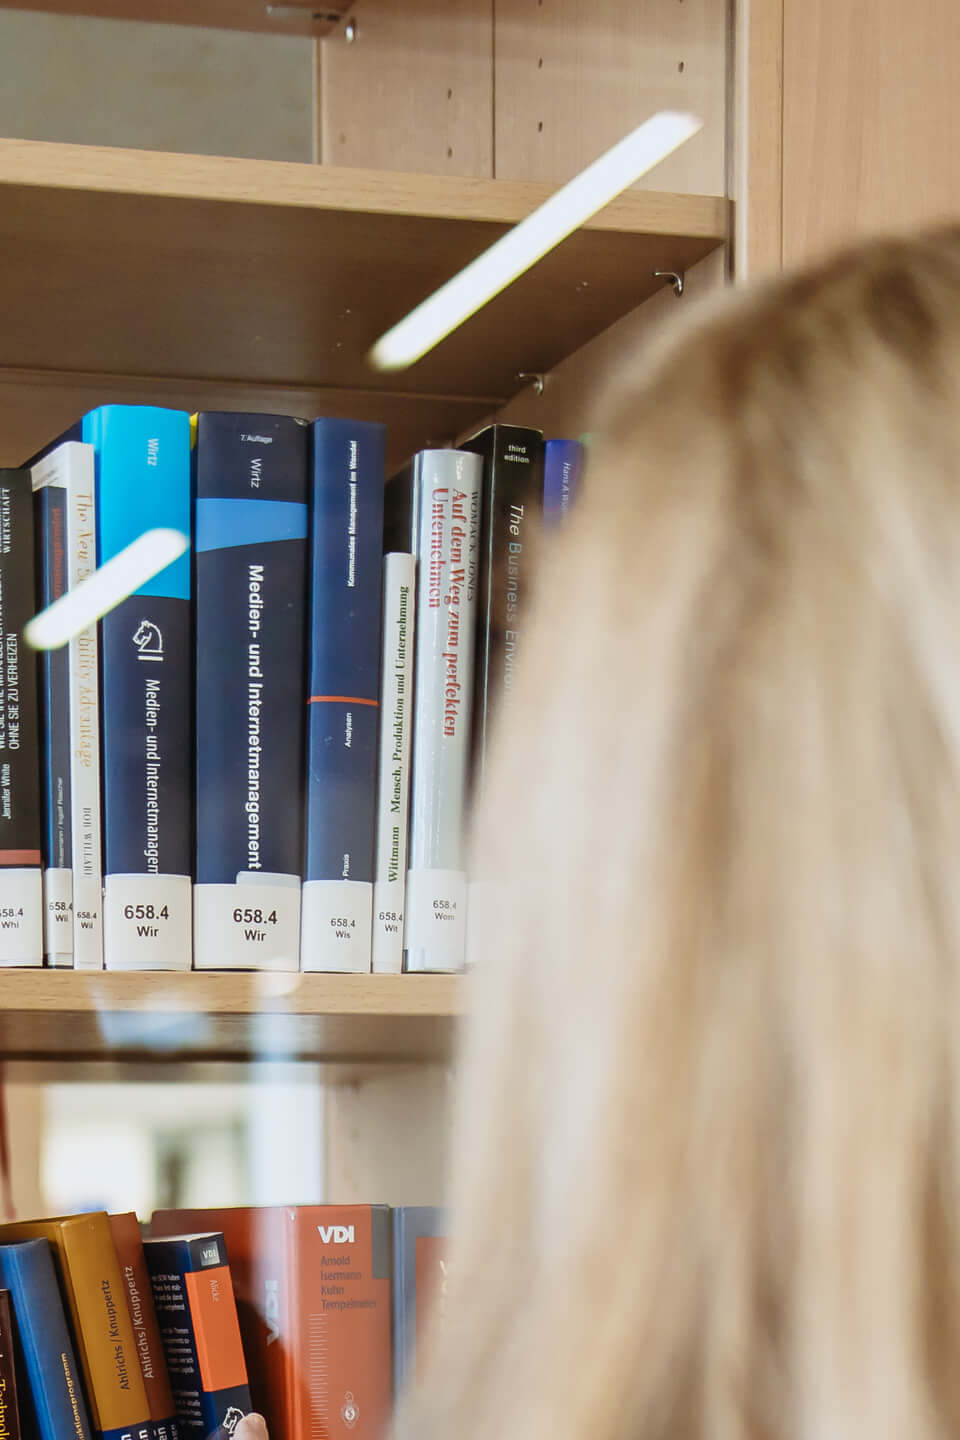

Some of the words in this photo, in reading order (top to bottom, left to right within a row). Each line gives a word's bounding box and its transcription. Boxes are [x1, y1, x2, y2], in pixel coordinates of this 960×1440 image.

[146, 438, 159, 467] Wirtz
[250, 458, 262, 488] Wirtz
[348, 482, 358, 535] Management
[451, 488, 468, 524] Auf
[428, 487, 450, 609] Unternehmen
[449, 526, 467, 564] dem
[444, 567, 466, 607] Weg
[467, 560, 477, 602] JONES
[248, 565, 264, 639] Medien-
[394, 585, 409, 669] Unternehmung
[446, 609, 461, 647] zum
[6, 633, 19, 688] VERHEIZEN
[248, 644, 264, 678] und
[7, 690, 18, 702] ZU
[397, 673, 406, 694] und
[442, 651, 462, 737] perfekten
[7, 704, 18, 720] SIE
[144, 679, 161, 733] Medien-
[6, 722, 19, 750] OHNE
[344, 712, 353, 748] Analysen
[392, 697, 405, 761] Produktion
[144, 736, 161, 760] und
[245, 683, 263, 870] Internetmanagement
[390, 766, 402, 813] Mensch,
[1, 785, 12, 820] Jennifer
[342, 854, 350, 877] Praxis
[388, 825, 400, 883] Wittmann
[124, 904, 170, 920] 658.4
[232, 909, 278, 924] 658.4
[330, 918, 356, 928] 658.4
[378, 912, 403, 922] 658.4
[136, 926, 159, 937] Wir
[244, 929, 267, 942] Wir
[317, 1225, 355, 1244] VDI
[320, 1255, 351, 1266] Arnold
[320, 1270, 362, 1281] Isermann
[320, 1285, 345, 1296] Kuhn
